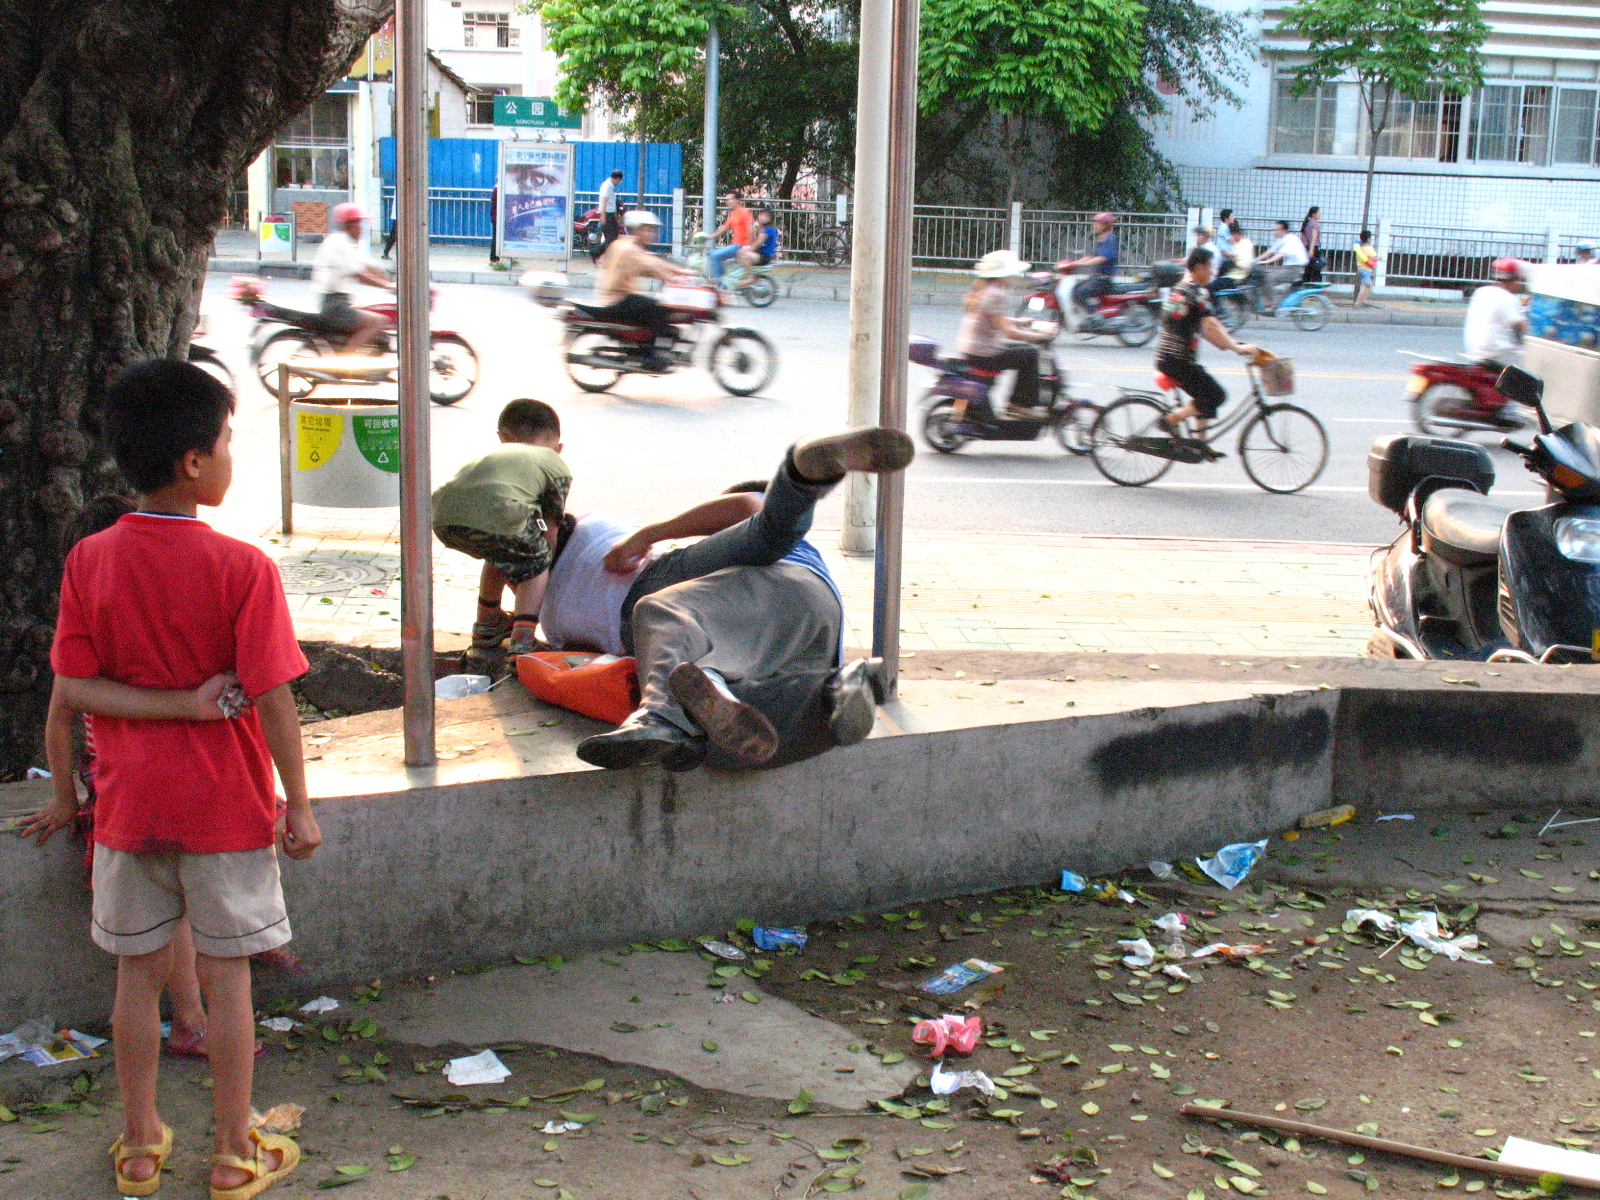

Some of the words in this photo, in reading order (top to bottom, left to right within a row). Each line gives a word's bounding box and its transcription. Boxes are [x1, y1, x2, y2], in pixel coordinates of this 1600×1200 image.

[301, 415, 331, 427] 其它垃圾
[364, 418, 398, 428] 可回收物
